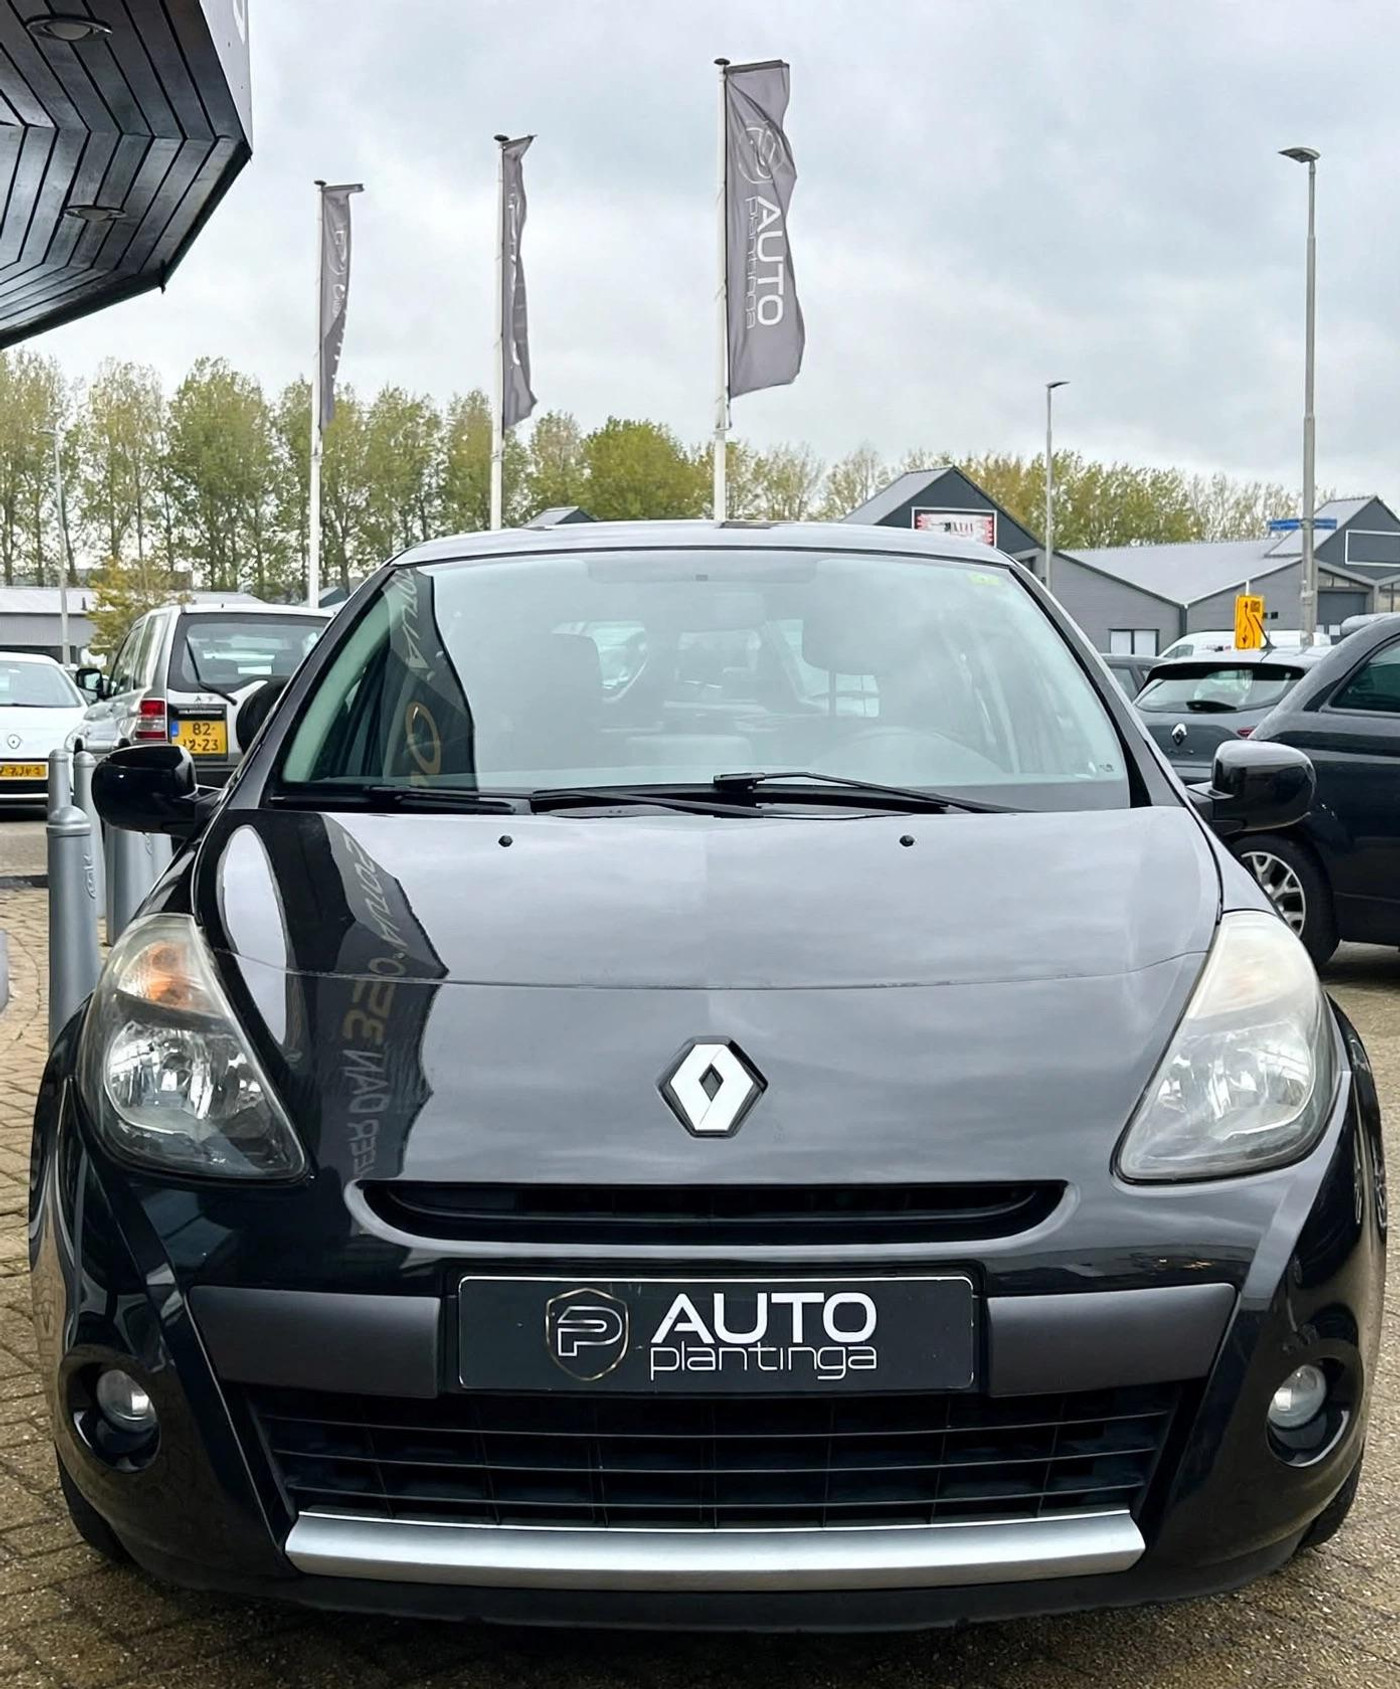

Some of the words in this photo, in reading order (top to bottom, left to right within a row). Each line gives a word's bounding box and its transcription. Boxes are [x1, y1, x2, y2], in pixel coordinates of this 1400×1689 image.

[757, 196, 784, 326] AUTO
[651, 1291, 878, 1344] AUTO
[651, 1340, 878, 1381] plantinga
